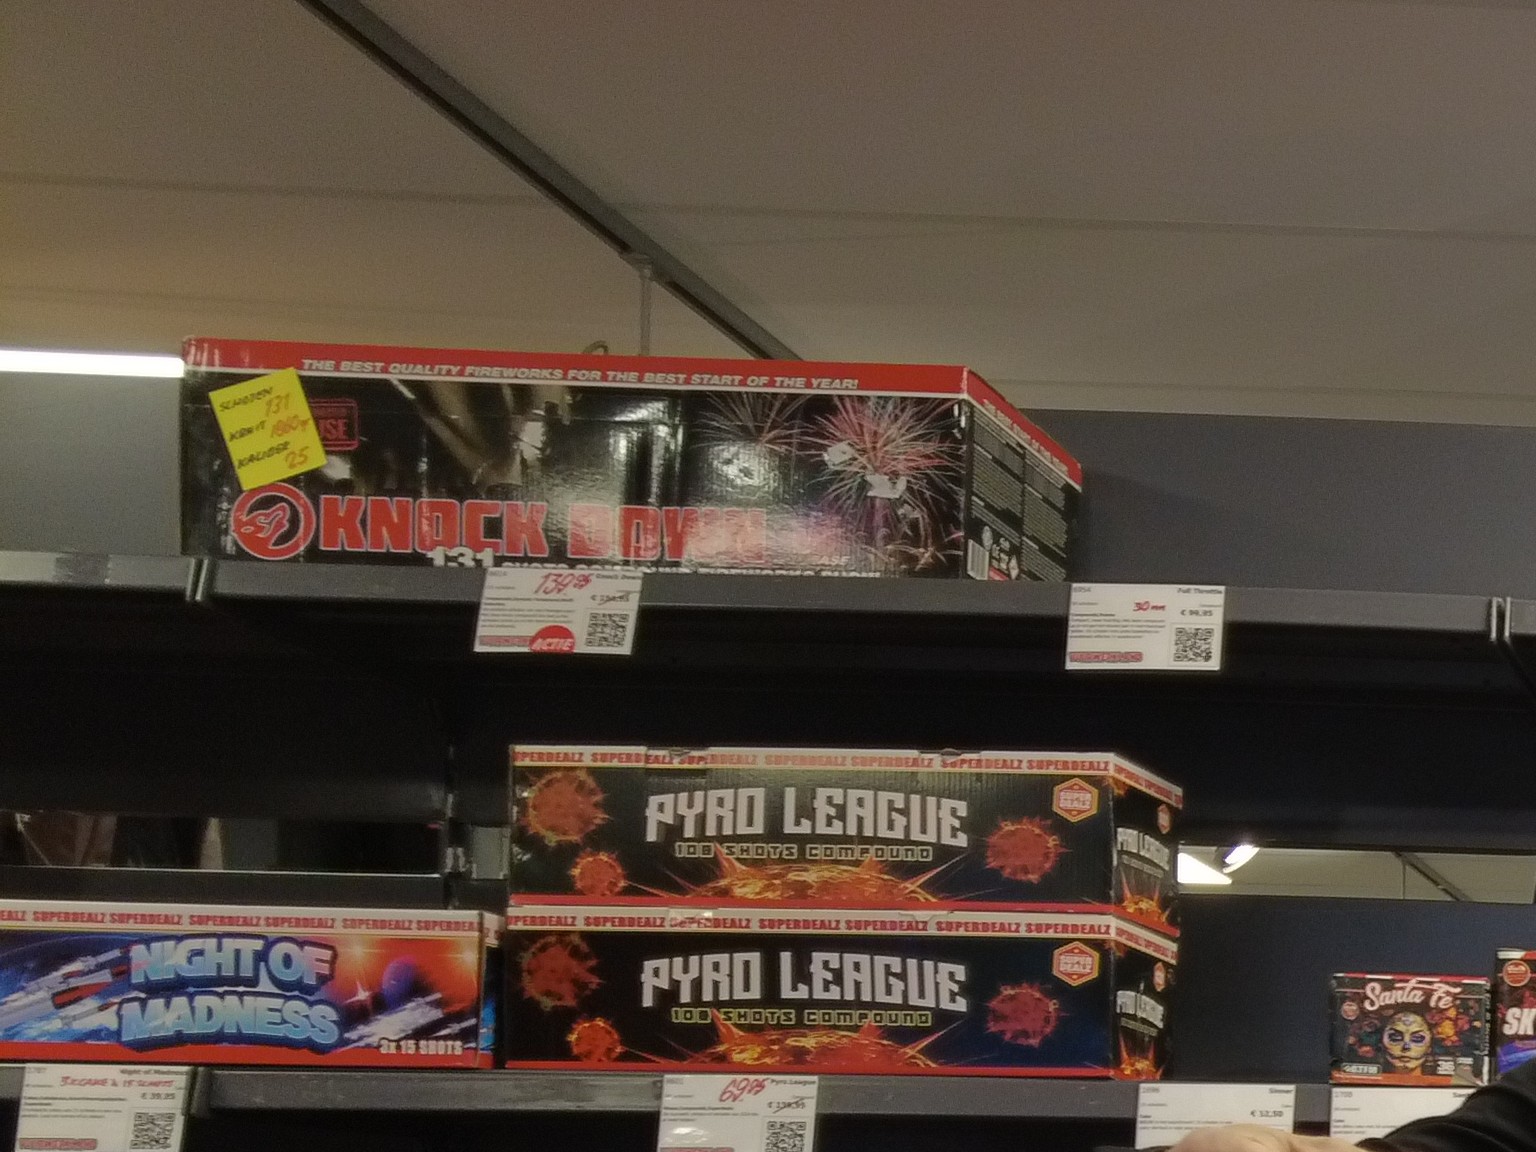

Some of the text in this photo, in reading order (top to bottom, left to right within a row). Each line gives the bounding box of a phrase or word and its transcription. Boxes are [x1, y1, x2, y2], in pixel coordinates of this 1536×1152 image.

[303, 359, 858, 390] THE BEST QUALITY FIREWORKS FOR THE BEST START OF THE YEAR!
[319, 495, 549, 558] KNOCK
[765, 754, 1110, 772] SUPERDEALZ SUPERDEALZ SUPERDEALZ SUPERDEALZ
[645, 786, 969, 848] PYRO LEAGUE
[725, 843, 933, 861] SHOTS COMPOUND
[33, 910, 413, 931] SUPERDEALZ SUPERDEALZ SUPERDEALZ SUPERDEALZ SUPERDEALZ
[583, 916, 1111, 936] SUPERDEALZ SUPERDEALZ SUPERDEALZ SUPERDEALZ SUPERDEALZ
[129, 937, 333, 985] NIGHT OF
[641, 951, 967, 1012] PYRO LEAGUE
[1364, 977, 1462, 1011] Santa Fe
[121, 998, 340, 1045] MADNESS
[720, 1008, 932, 1026] SHOTS COMPOUND
[402, 1040, 415, 1054] 15
[419, 1041, 464, 1055] SHOTS
